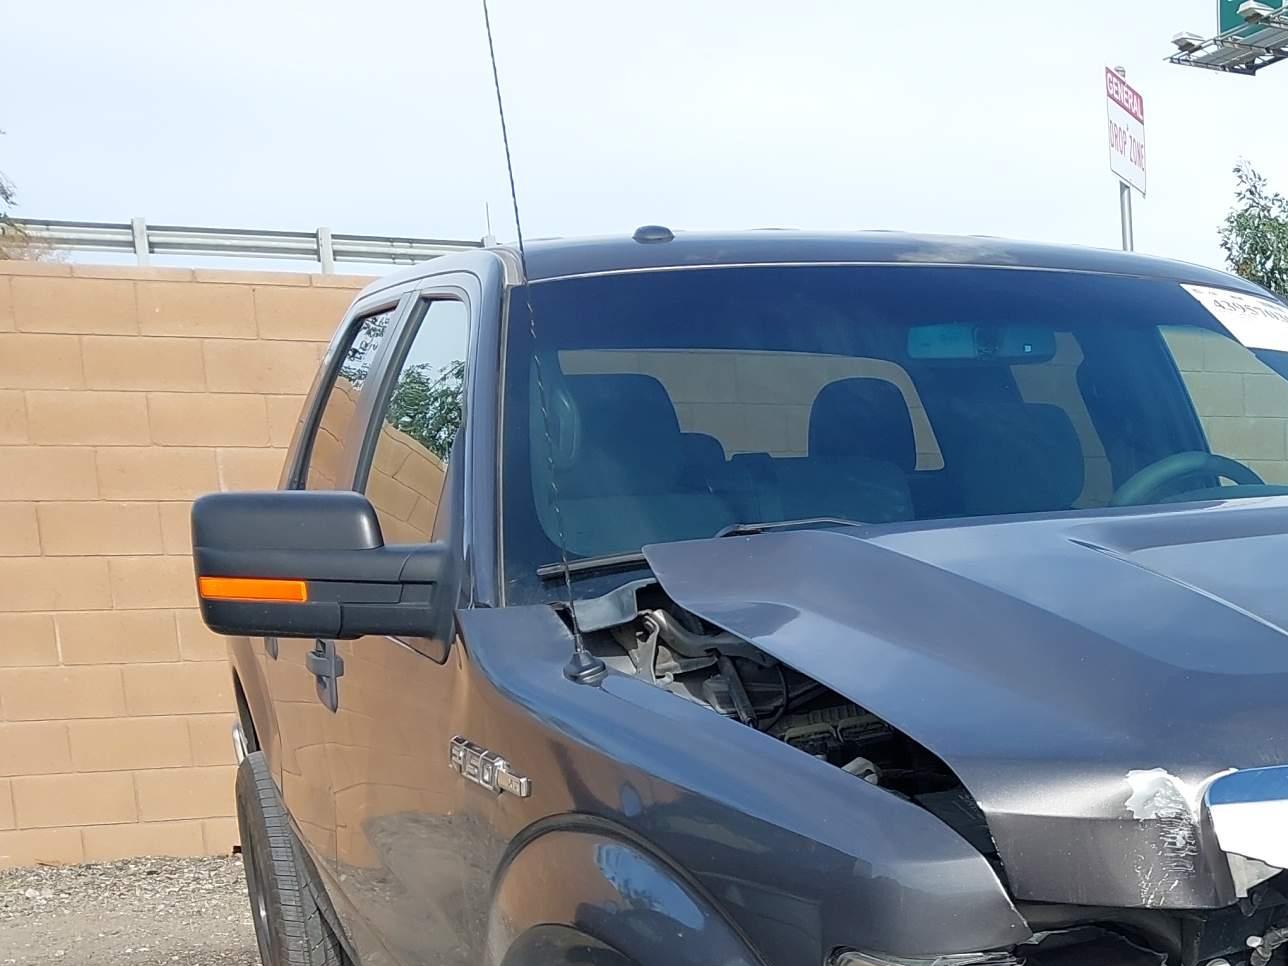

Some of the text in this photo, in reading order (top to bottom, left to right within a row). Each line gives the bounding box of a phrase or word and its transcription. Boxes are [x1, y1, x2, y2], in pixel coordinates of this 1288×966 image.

[1107, 72, 1143, 120] GENERAL
[1109, 120, 1145, 172] DROP ZONE
